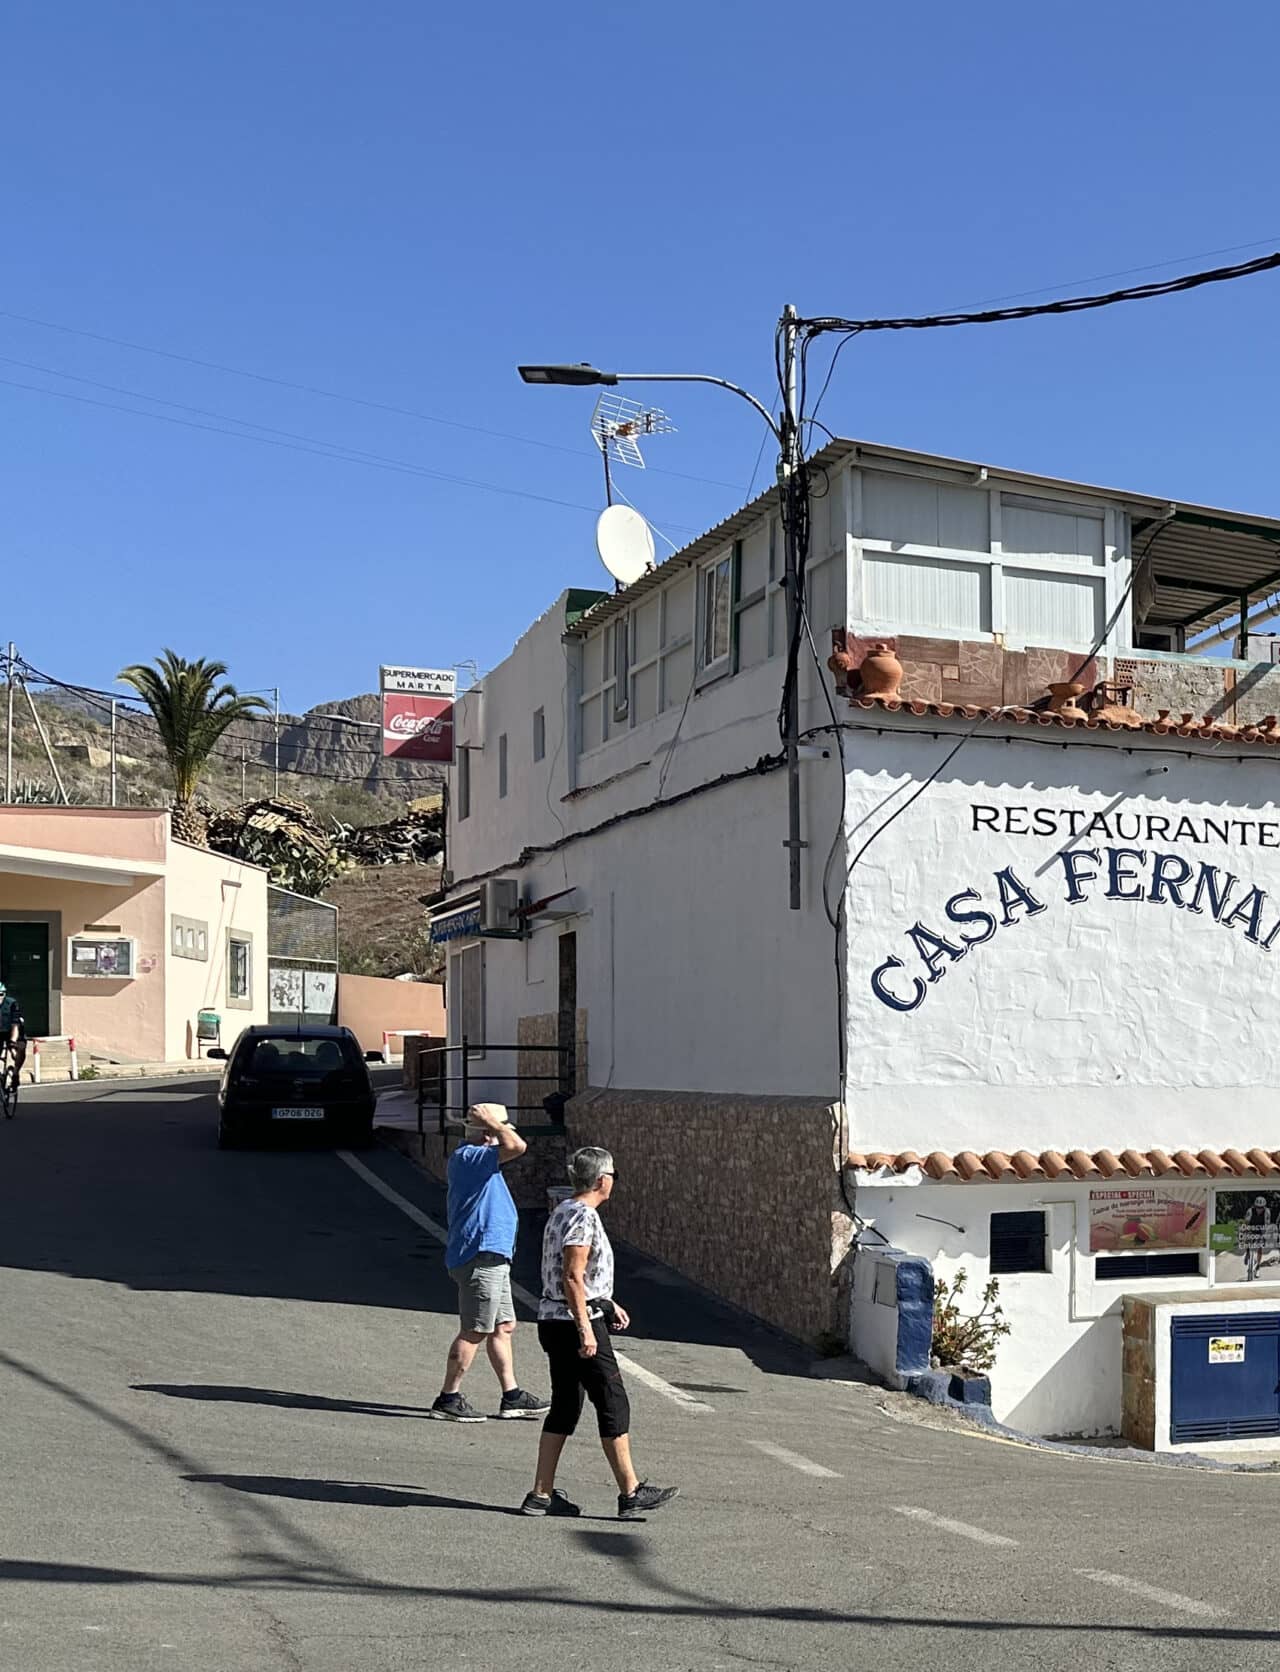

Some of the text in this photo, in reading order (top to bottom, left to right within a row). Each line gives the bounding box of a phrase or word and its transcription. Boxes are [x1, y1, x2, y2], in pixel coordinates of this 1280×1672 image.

[384, 669, 454, 681] SUPERMERCADO
[397, 682, 441, 691] MARTA
[970, 804, 1280, 848] RESTAURANTE
[871, 865, 1047, 1012] CASA
